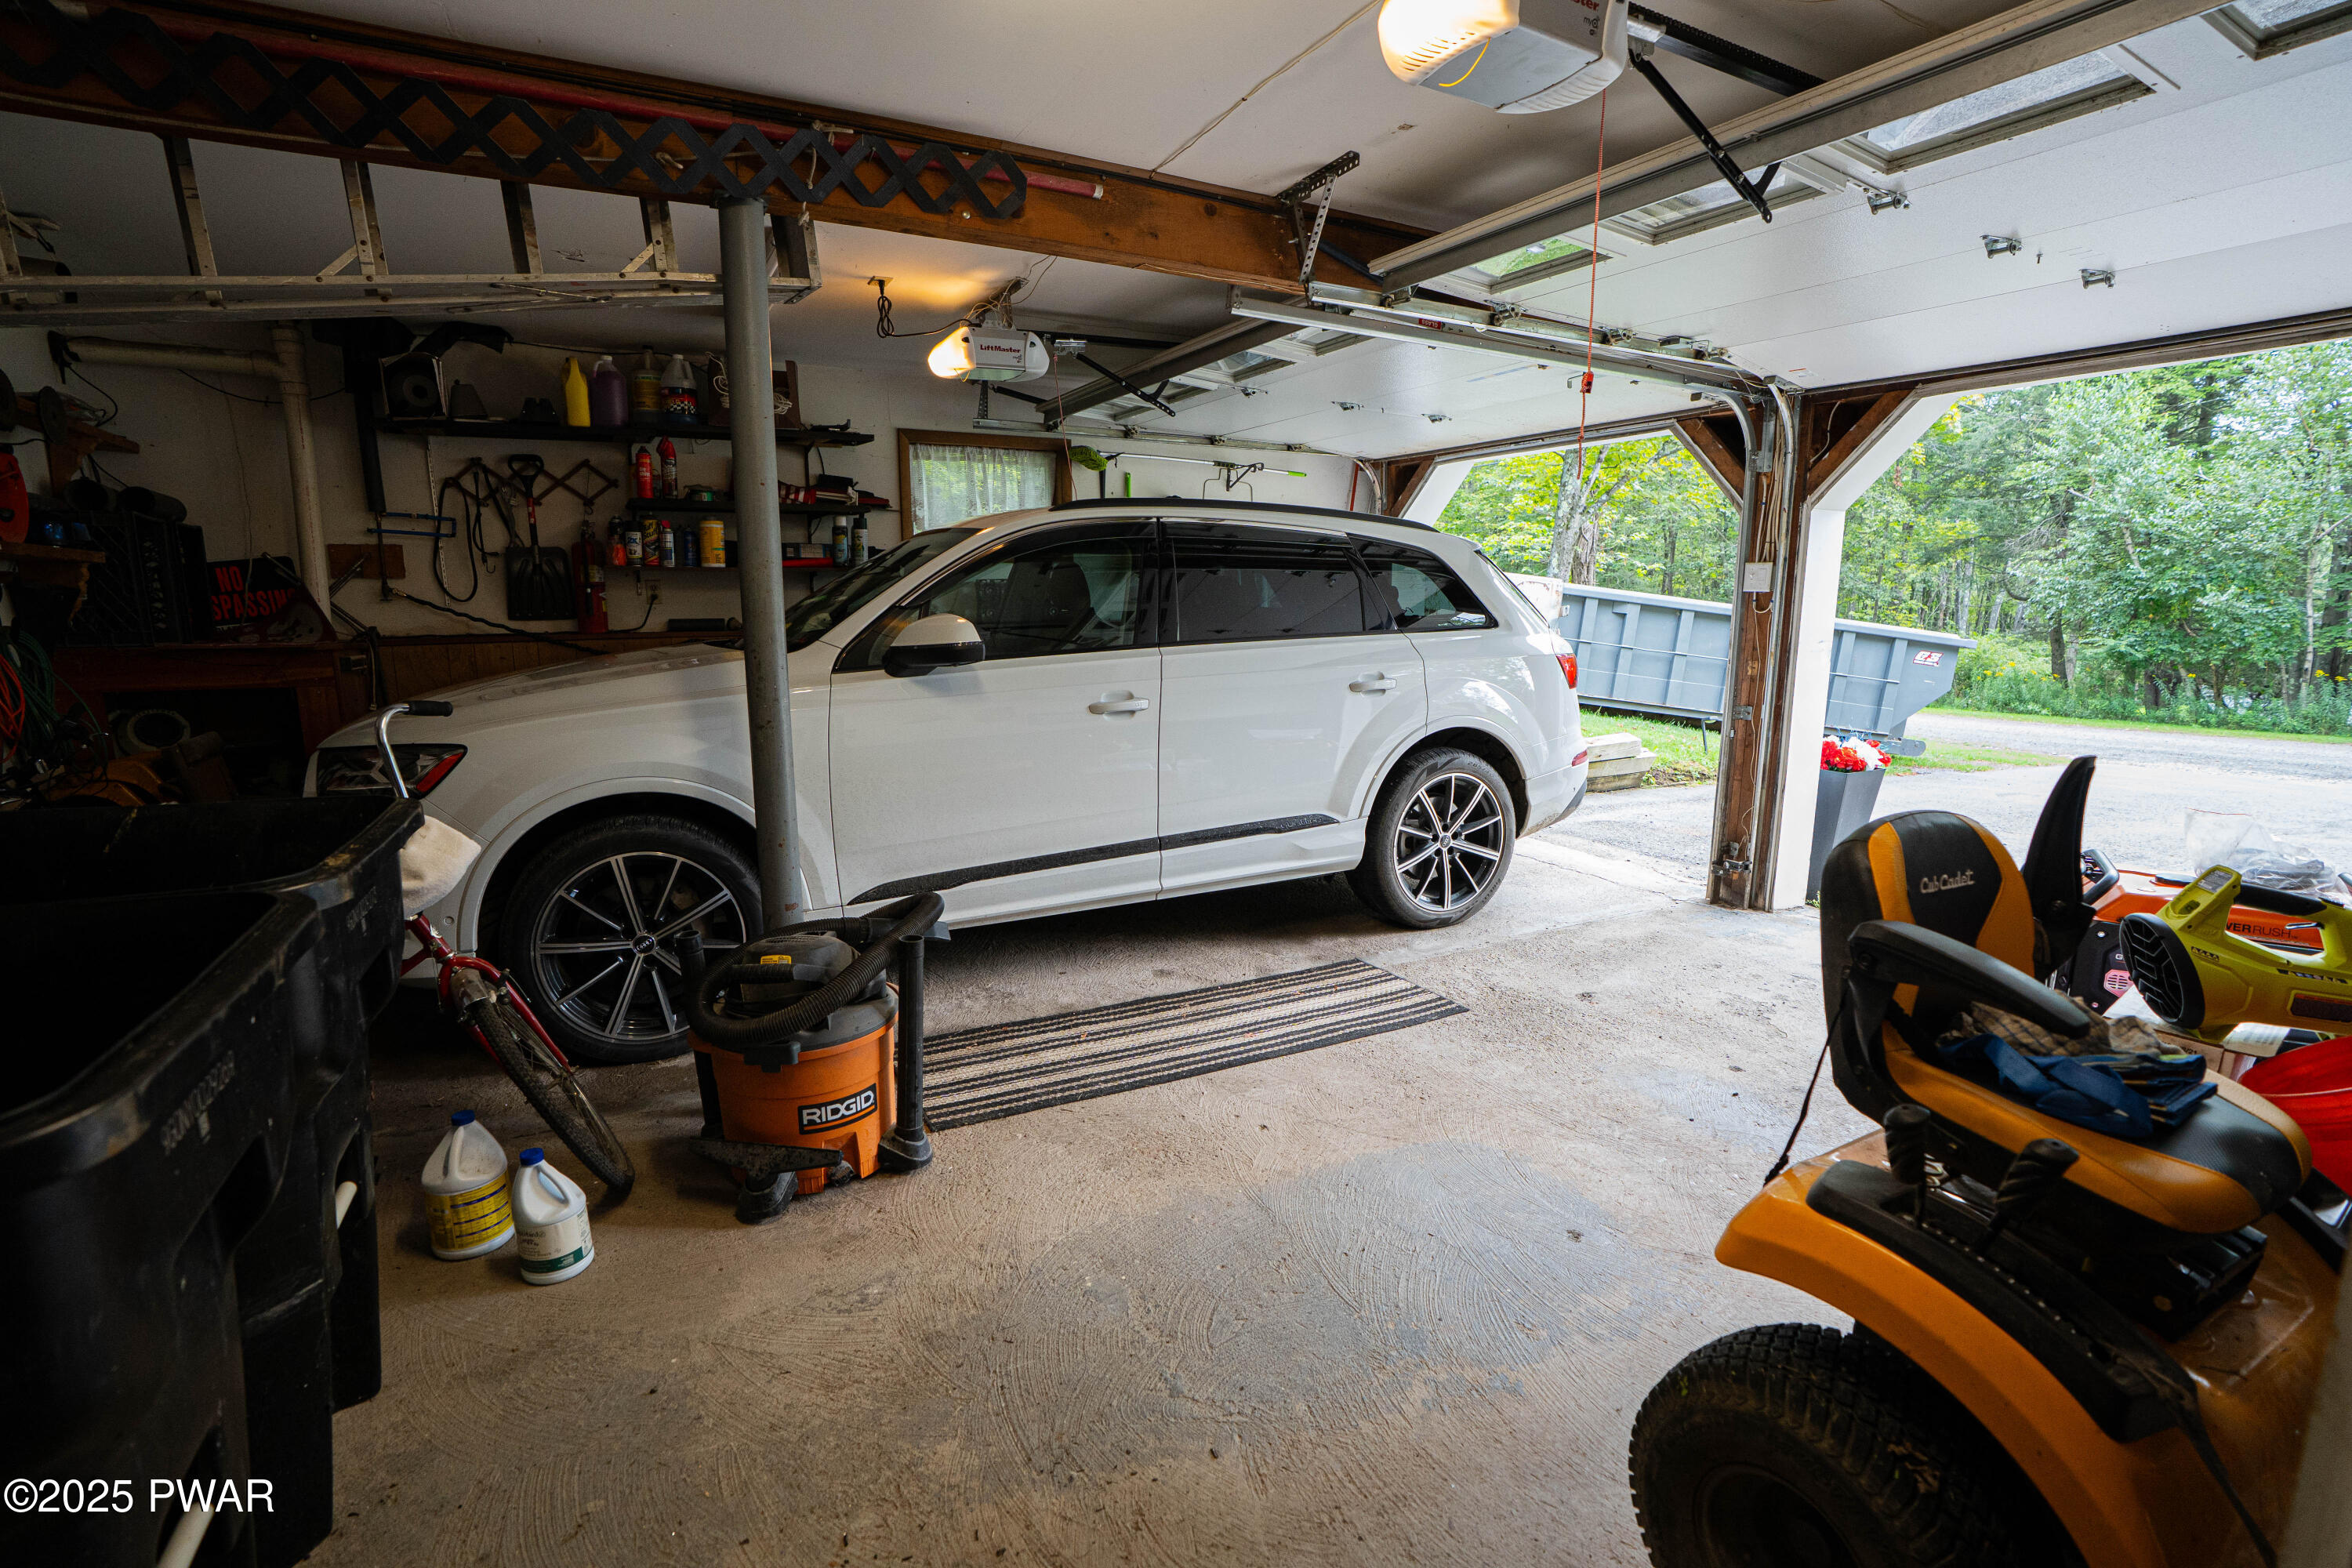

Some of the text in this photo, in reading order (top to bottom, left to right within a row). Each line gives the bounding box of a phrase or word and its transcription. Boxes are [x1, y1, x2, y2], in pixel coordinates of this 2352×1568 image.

[980, 344, 1021, 354] LiftMaster
[213, 565, 245, 593] NO
[1920, 869, 1976, 894] Cub Cadet
[803, 1090, 873, 1125] RIDGID
